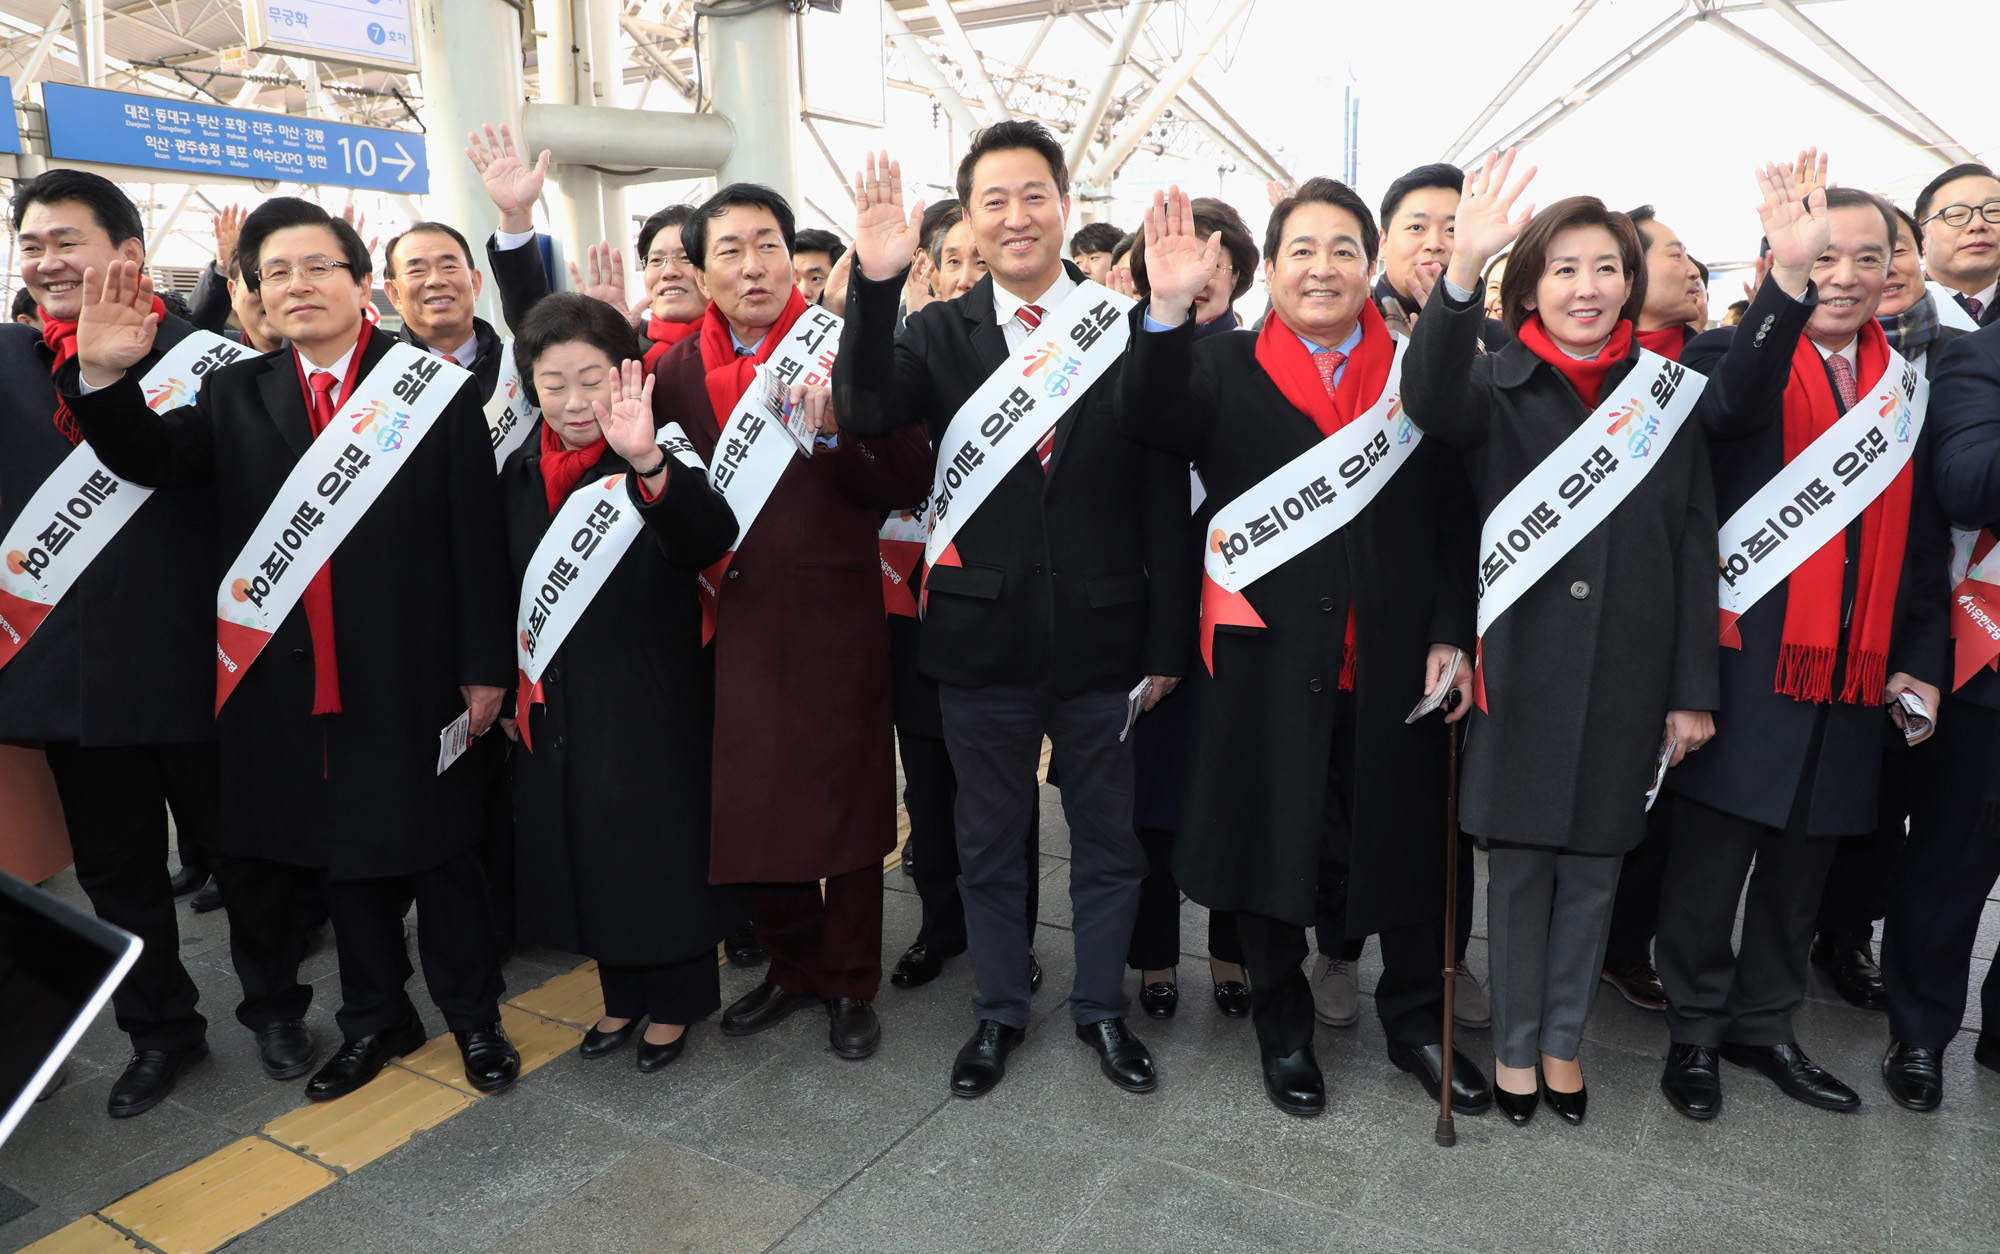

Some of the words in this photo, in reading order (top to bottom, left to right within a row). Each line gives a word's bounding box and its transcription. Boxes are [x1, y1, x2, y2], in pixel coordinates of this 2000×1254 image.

[269, 7, 309, 28] 무궁화
[371, 26, 381, 41] 7
[388, 31, 407, 46] 호차
[125, 120, 151, 129] Daejeon
[203, 130, 220, 138] Busan
[226, 133, 247, 142] Pohang
[306, 154, 328, 169] 방면
[337, 137, 378, 177] 10
[796, 312, 838, 356] 다시
[1069, 300, 1122, 352] 새해
[392, 355, 443, 406] 새해
[1650, 357, 1687, 410] 새해
[980, 385, 1037, 446] 많이
[316, 443, 371, 506] 많이
[713, 412, 767, 495] 대한민
[1337, 429, 1391, 490] 많이
[1557, 444, 1620, 509] 많이
[1831, 425, 1889, 488] 많이
[570, 498, 621, 560] 많이
[1217, 475, 1338, 566] 받으세요
[1719, 477, 1837, 588] 받으세요
[243, 500, 326, 608] 받으세요
[526, 555, 580, 660] 받으세요
